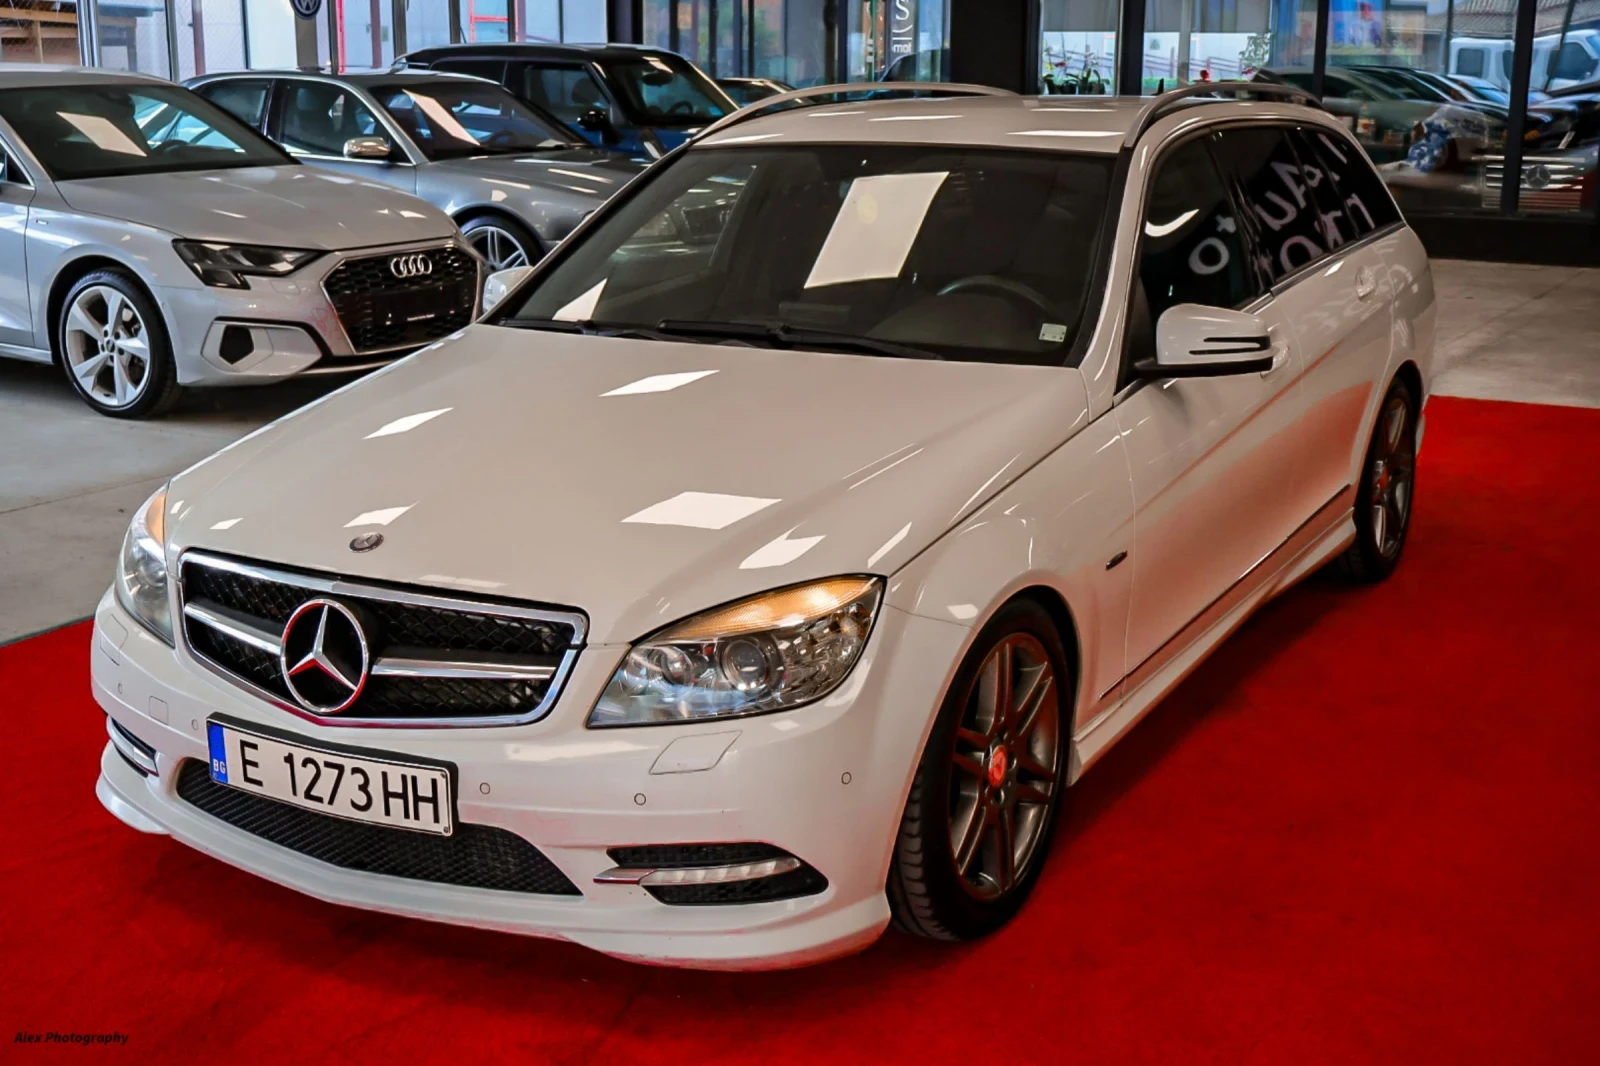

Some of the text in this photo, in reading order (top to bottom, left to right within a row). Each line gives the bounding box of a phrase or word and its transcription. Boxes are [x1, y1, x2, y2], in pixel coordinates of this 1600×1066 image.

[212, 758, 226, 774] BG
[239, 739, 440, 824] E 1273 HH
